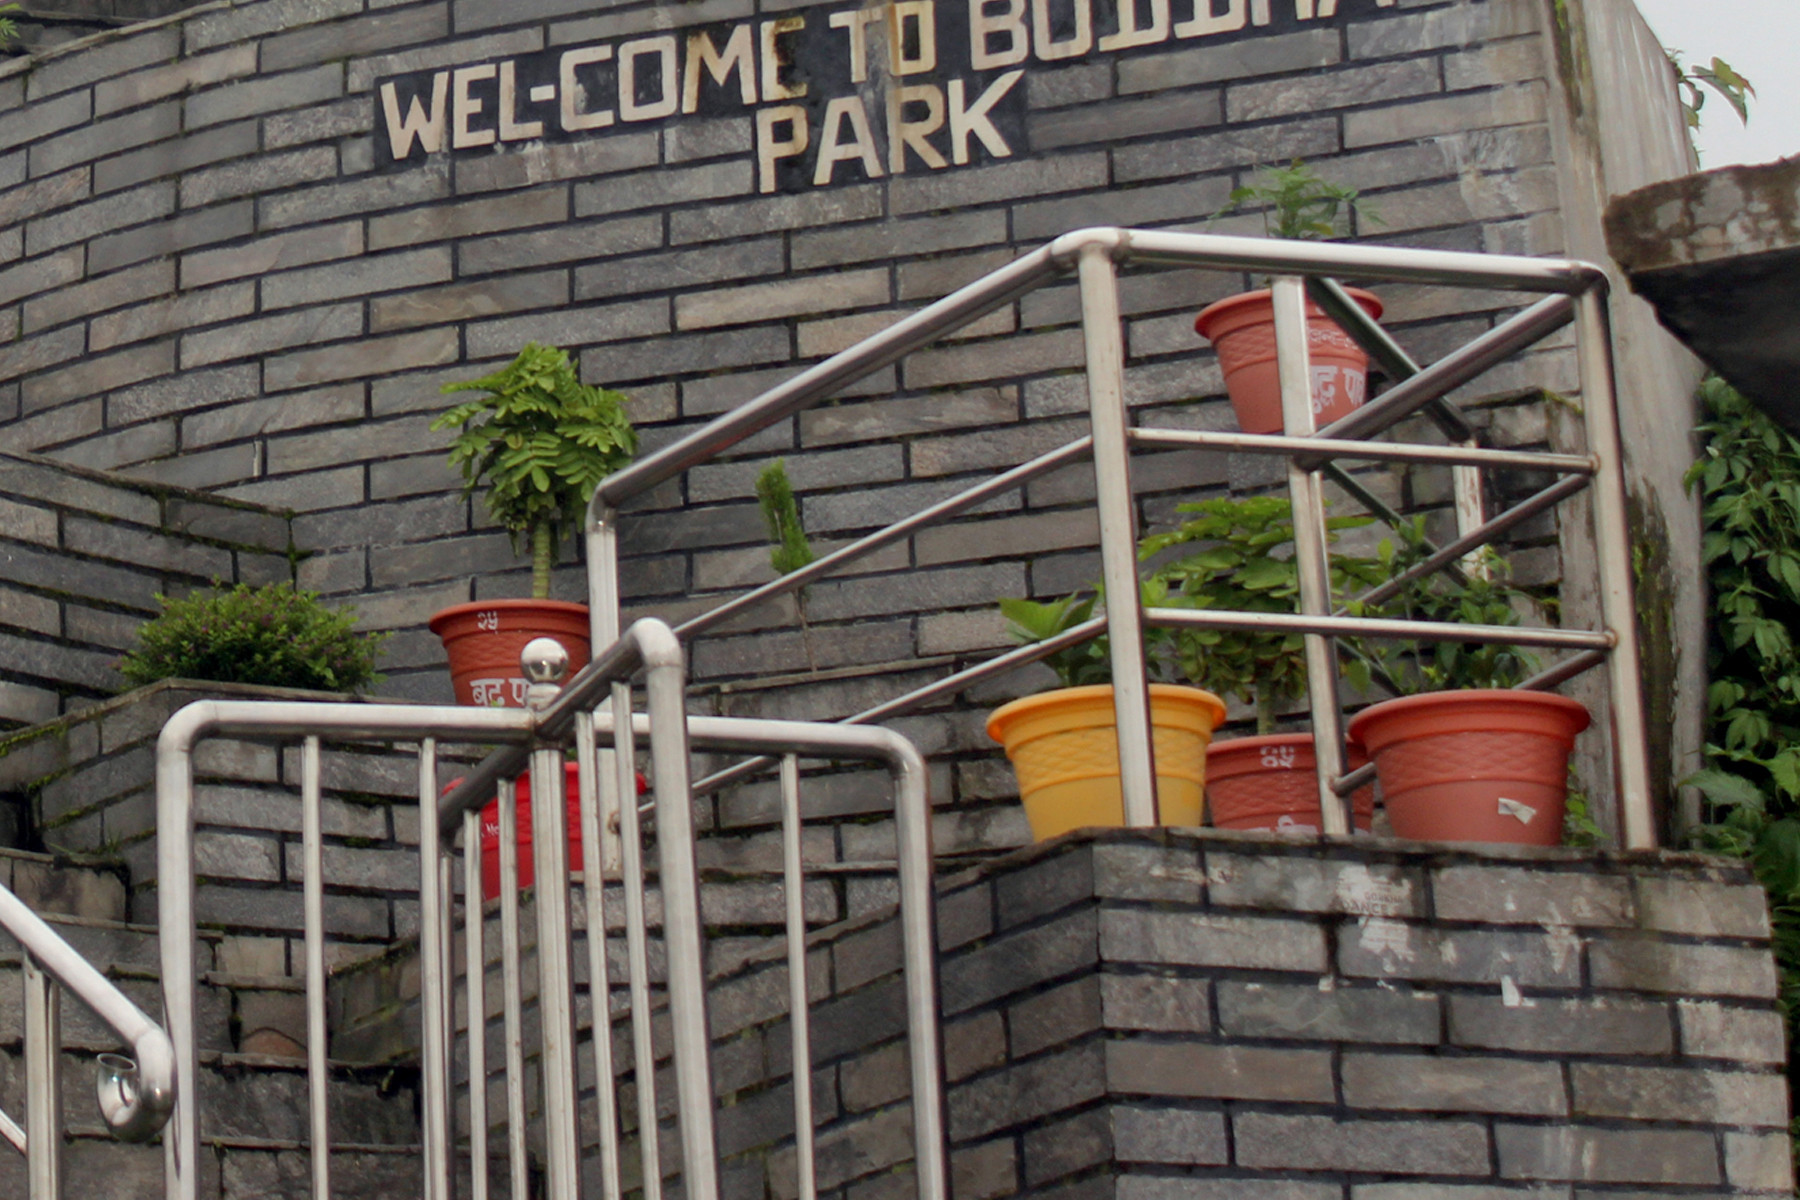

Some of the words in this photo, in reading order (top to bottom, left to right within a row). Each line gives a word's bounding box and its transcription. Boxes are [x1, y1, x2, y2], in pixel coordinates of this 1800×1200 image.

[379, 17, 808, 162] WEL-COME
[841, 0, 936, 84] TO
[756, 68, 1025, 195] PARK
